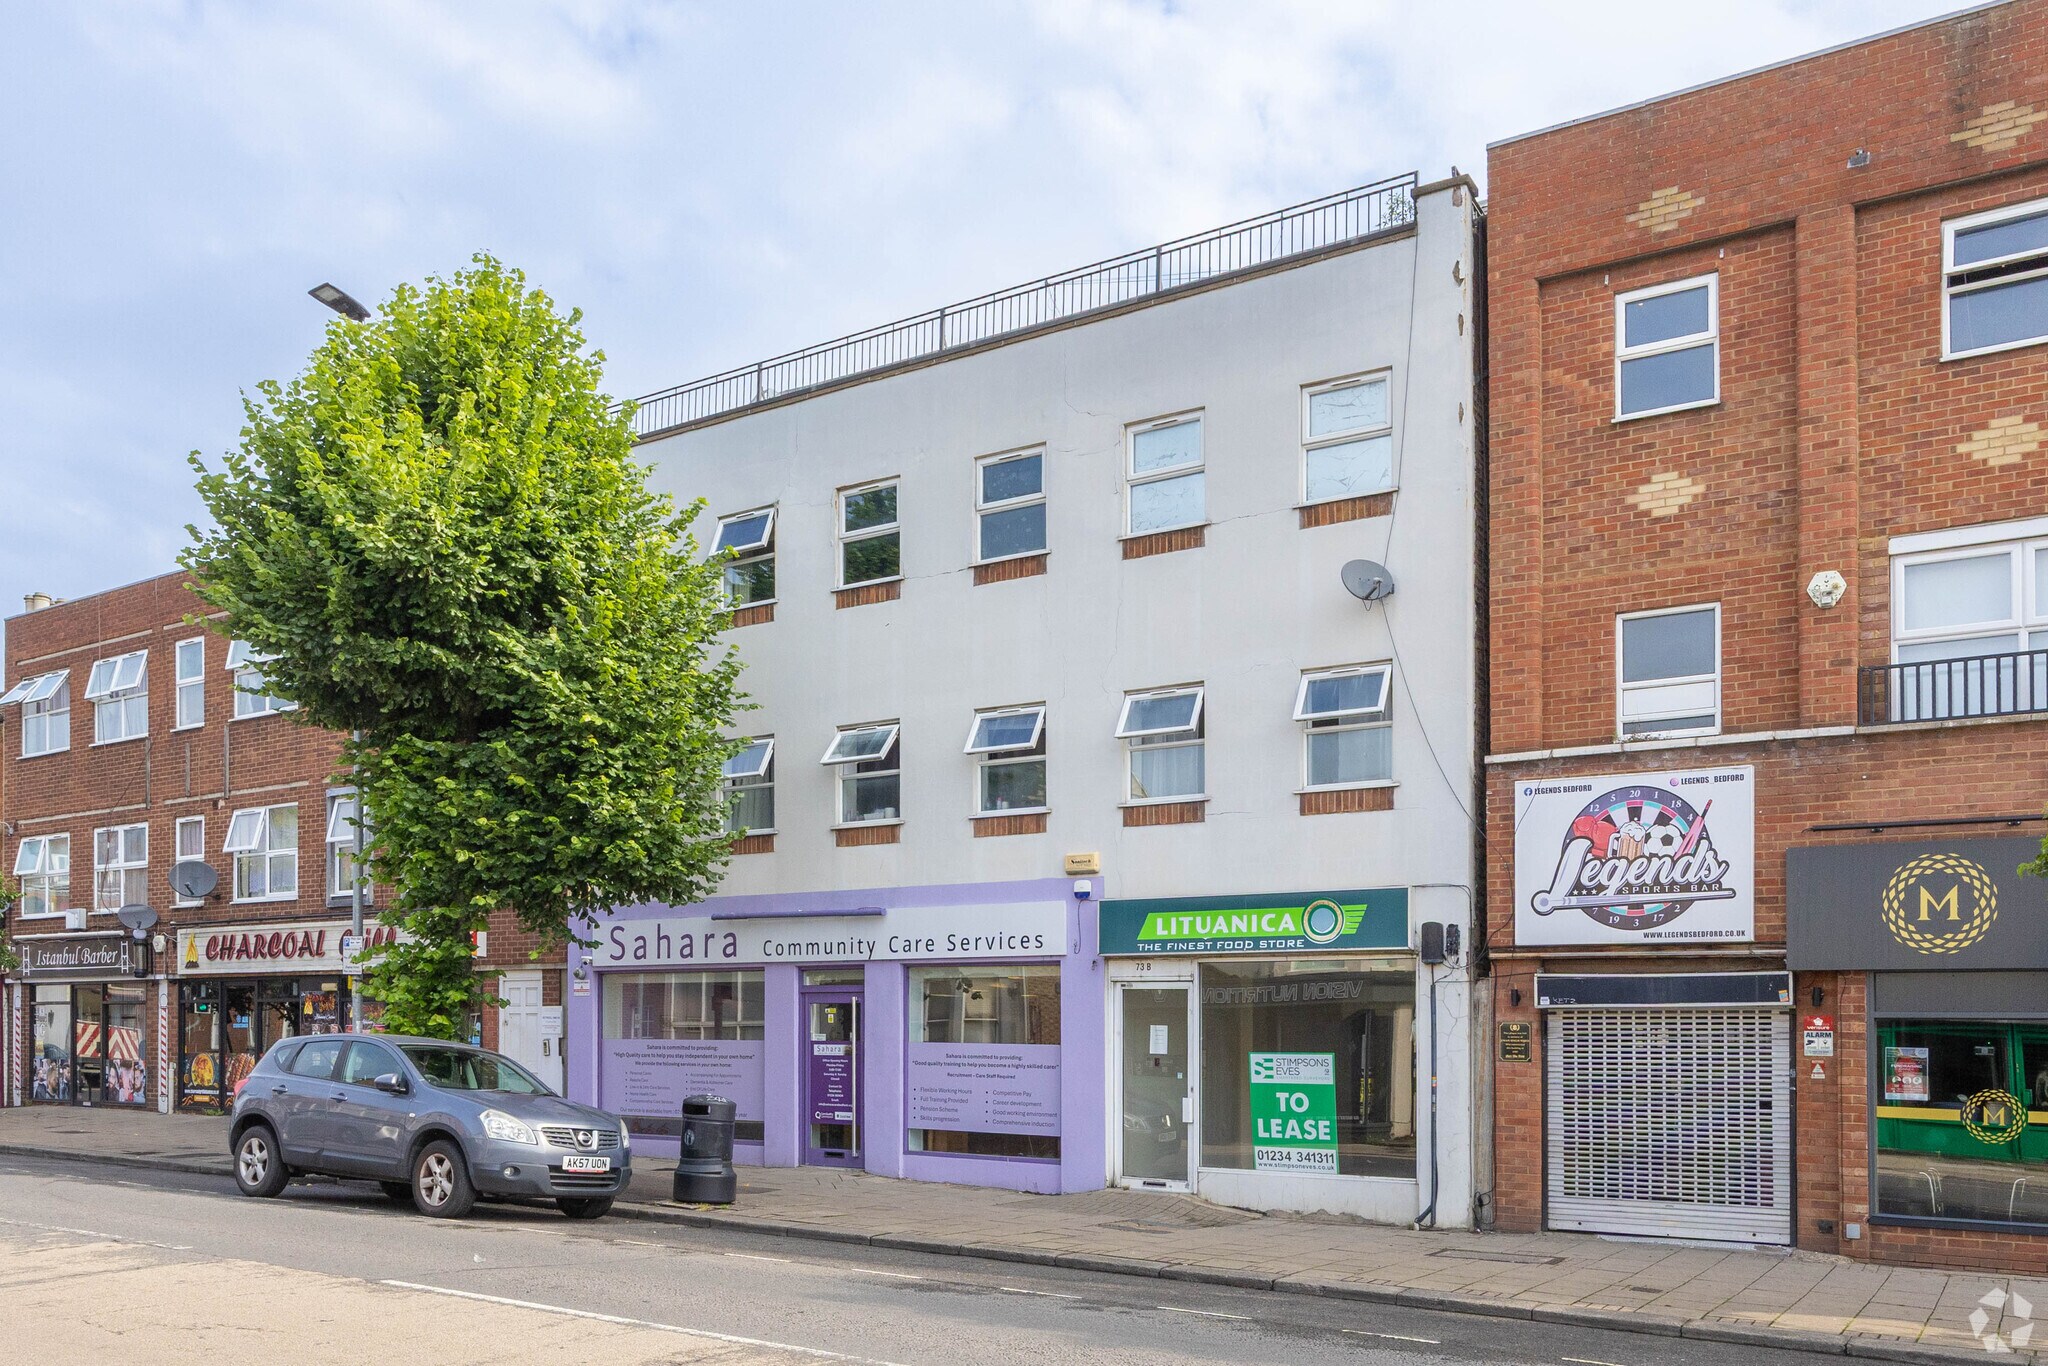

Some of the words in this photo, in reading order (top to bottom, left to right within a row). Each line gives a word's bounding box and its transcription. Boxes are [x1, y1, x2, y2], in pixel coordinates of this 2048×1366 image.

[1534, 786, 1562, 795] LEGENDS
[1562, 784, 1592, 793] BEDFORD
[1629, 790, 1641, 798] 20
[1610, 794, 1616, 802] 5
[1654, 791, 1659, 799] 1
[1589, 804, 1600, 812] 12
[1670, 800, 1682, 808] 18
[1687, 813, 1694, 821] 4
[1548, 836, 1730, 900] Legends
[1622, 884, 1681, 894] SPORTS
[1690, 883, 1720, 892] BAR
[1917, 884, 1962, 921] M
[1592, 907, 1598, 915] 7
[1608, 916, 1620, 924] 19
[1652, 914, 1664, 922] 17
[1156, 913, 1296, 936] LITUANICA
[1633, 919, 1640, 927] 3
[1643, 930, 1746, 939] WWW.LEGENDSBEDFORD.CO.UK
[205, 929, 326, 962] CHARCOAL
[609, 923, 738, 961] Sahara
[763, 937, 876, 960] Community
[889, 935, 935, 954] Care
[947, 931, 1045, 952] Services
[1137, 943, 1162, 952] THE
[1167, 942, 1213, 950] FINEST
[1216, 940, 1254, 950] FOOD
[1259, 939, 1305, 949] STORE
[36, 946, 82, 966] Istanbul
[81, 945, 119, 965] Barber
[1136, 963, 1145, 971] 73
[1146, 963, 1152, 971] B
[1276, 1058, 1330, 1067] STIMPSONS
[1276, 1067, 1301, 1076] EVES
[1276, 1092, 1310, 1113] TO
[1982, 1105, 2006, 1126] M
[1257, 1118, 1331, 1141] LEASE
[1257, 1150, 1292, 1162] 01234
[1296, 1152, 1335, 1164] 341311
[566, 1158, 589, 1168] AK57
[592, 1158, 607, 1168] UON
[1258, 1162, 1335, 1170] www.stimpsoneves.co.uk
